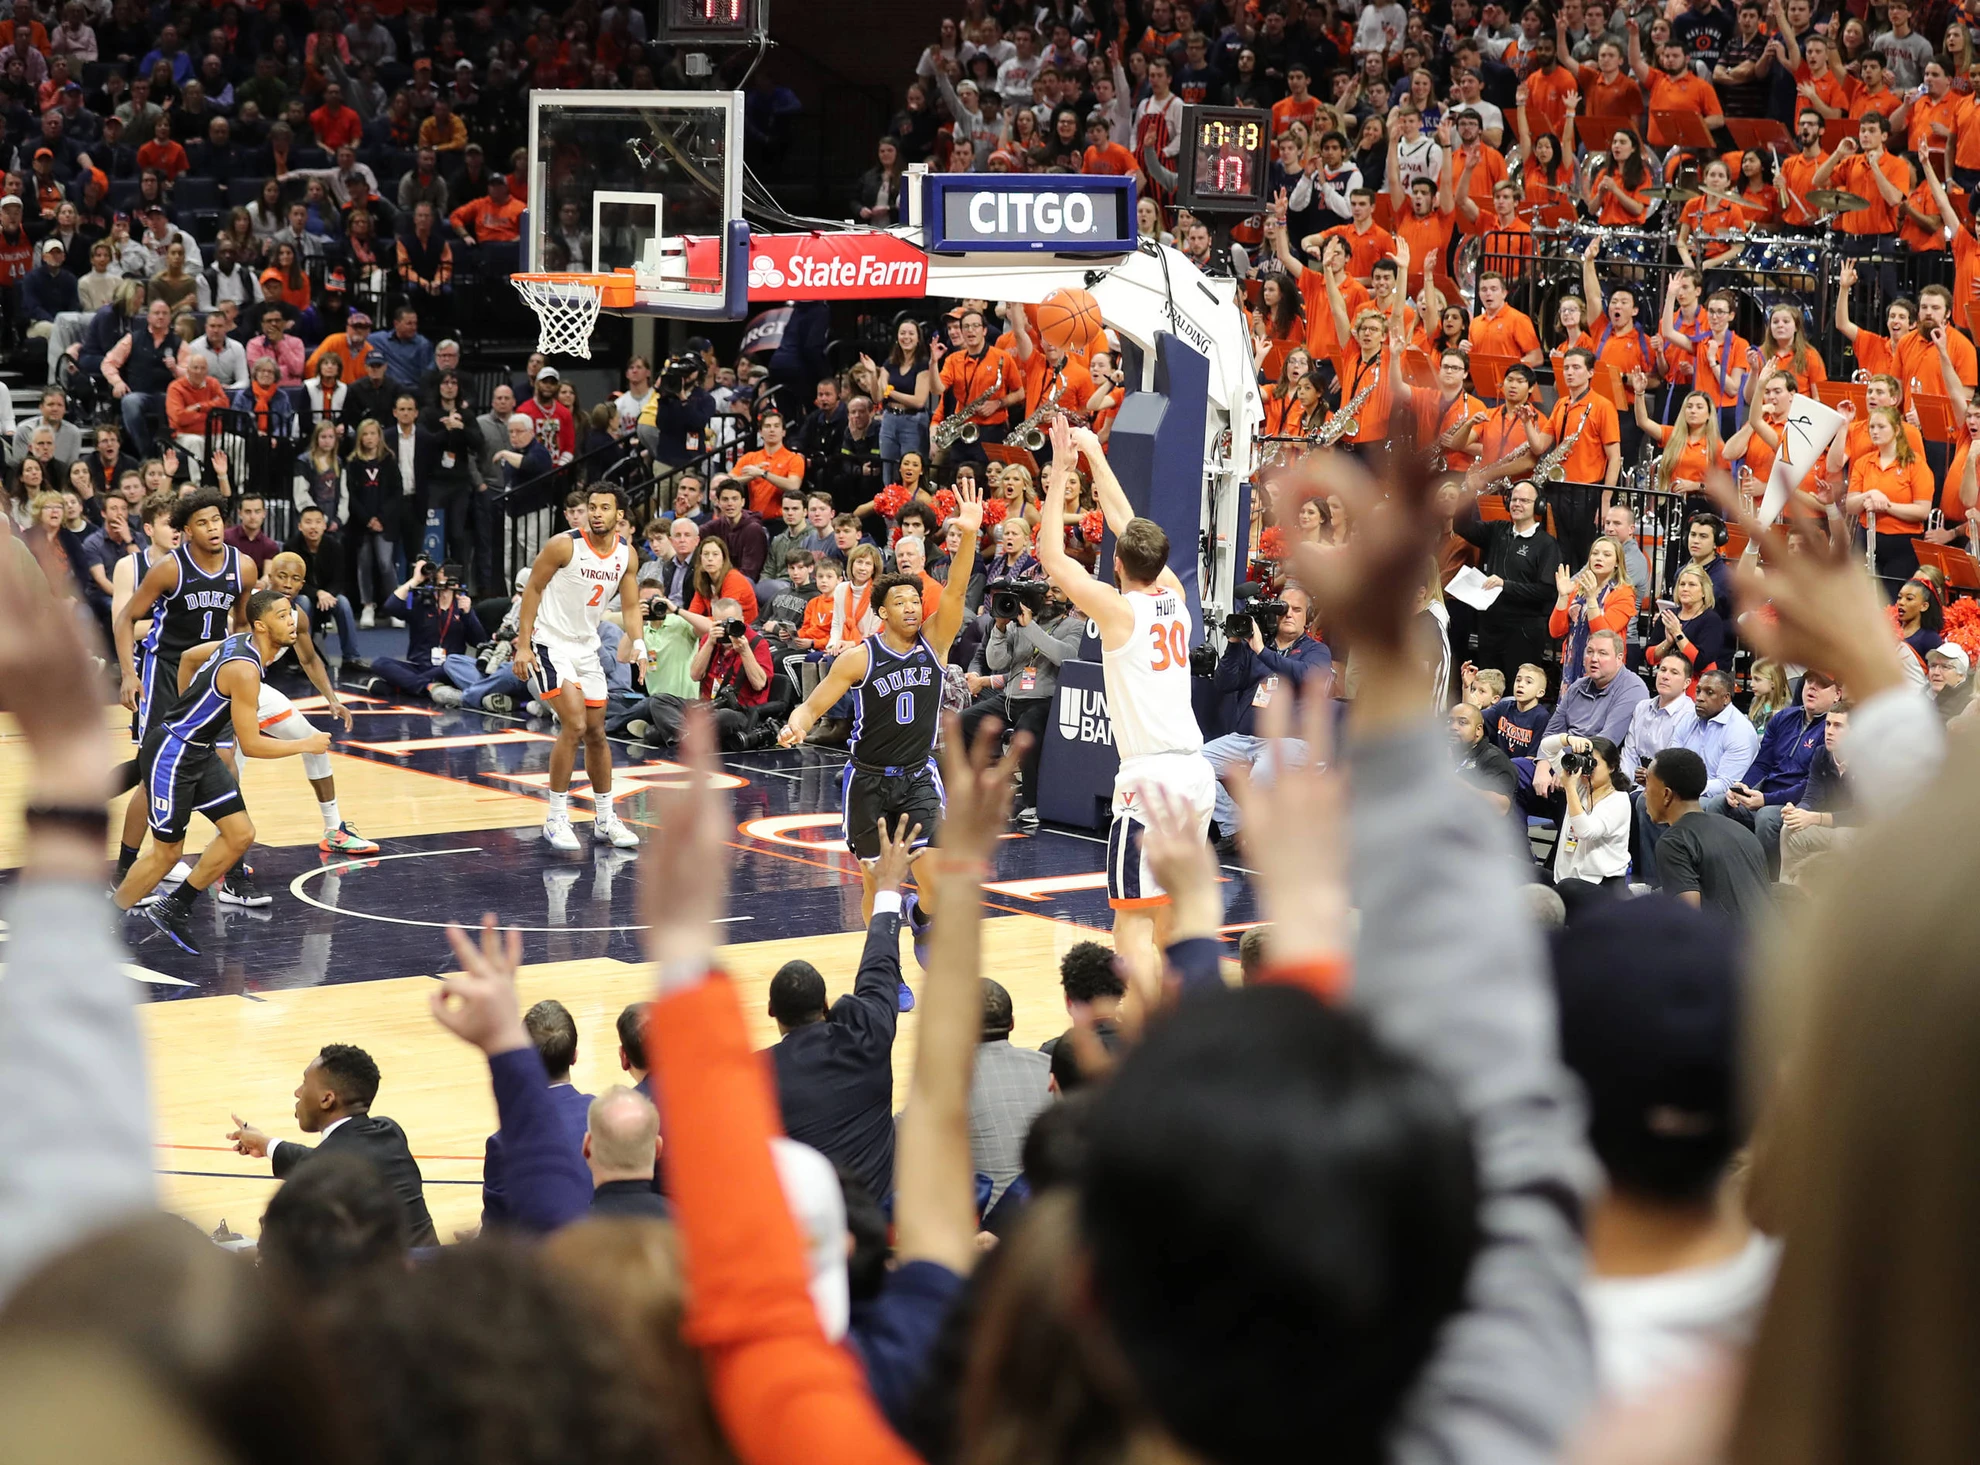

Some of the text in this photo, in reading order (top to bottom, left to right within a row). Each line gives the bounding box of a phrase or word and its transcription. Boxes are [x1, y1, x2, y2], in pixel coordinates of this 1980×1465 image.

[1203, 121, 1258, 151] 17:13
[1218, 156, 1243, 190] 17
[969, 191, 1093, 234] CITGO
[9, 263, 25, 277] 44
[1160, 300, 1212, 354] SPALDING
[580, 568, 619, 582] VIRGINIA
[184, 591, 236, 611] DUKE
[586, 584, 604, 607] 2
[1155, 599, 1176, 617] HUFF
[200, 611, 213, 640] 1
[1149, 620, 1186, 671] 30
[872, 666, 932, 698] DUKE
[895, 691, 915, 725] 0
